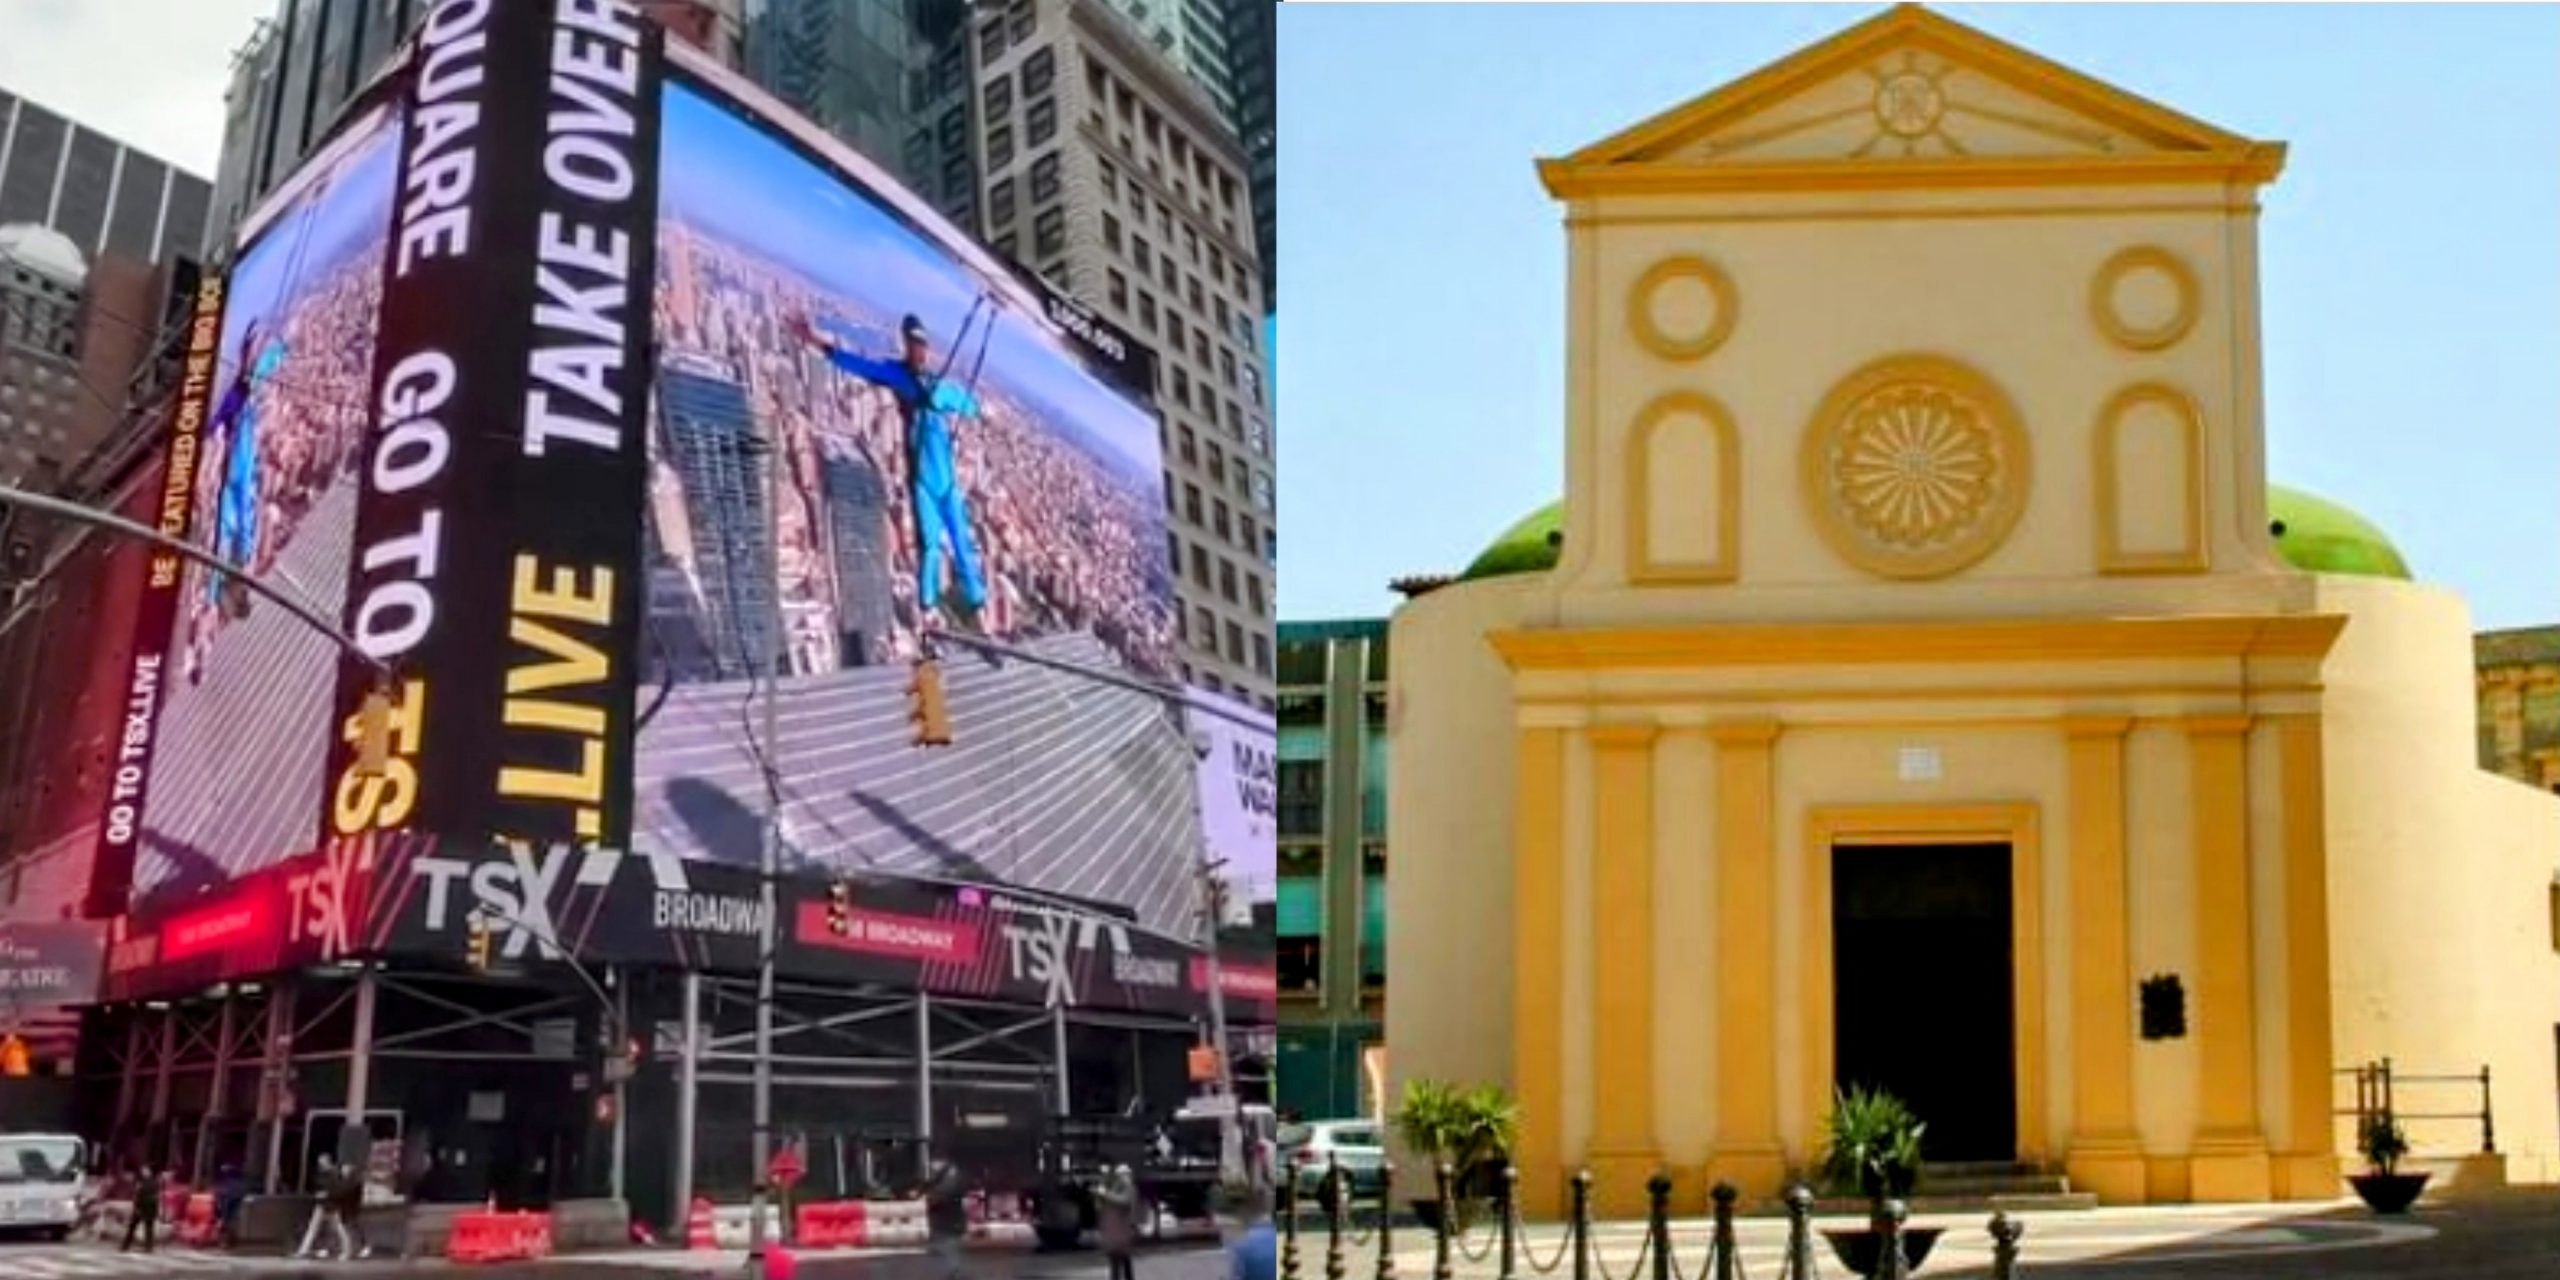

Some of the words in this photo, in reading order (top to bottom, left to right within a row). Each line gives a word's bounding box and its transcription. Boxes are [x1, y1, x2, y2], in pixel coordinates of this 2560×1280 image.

[543, 0, 642, 201] OVER
[524, 210, 630, 456] TAKE
[373, 351, 457, 493] GO
[160, 433, 196, 540] EATURED
[355, 509, 442, 659] TO
[112, 765, 141, 801] TO
[287, 838, 356, 960] TSX
[411, 838, 571, 961] TSX
[653, 889, 775, 934] BROADWA
[1002, 909, 1078, 1009] TSX
